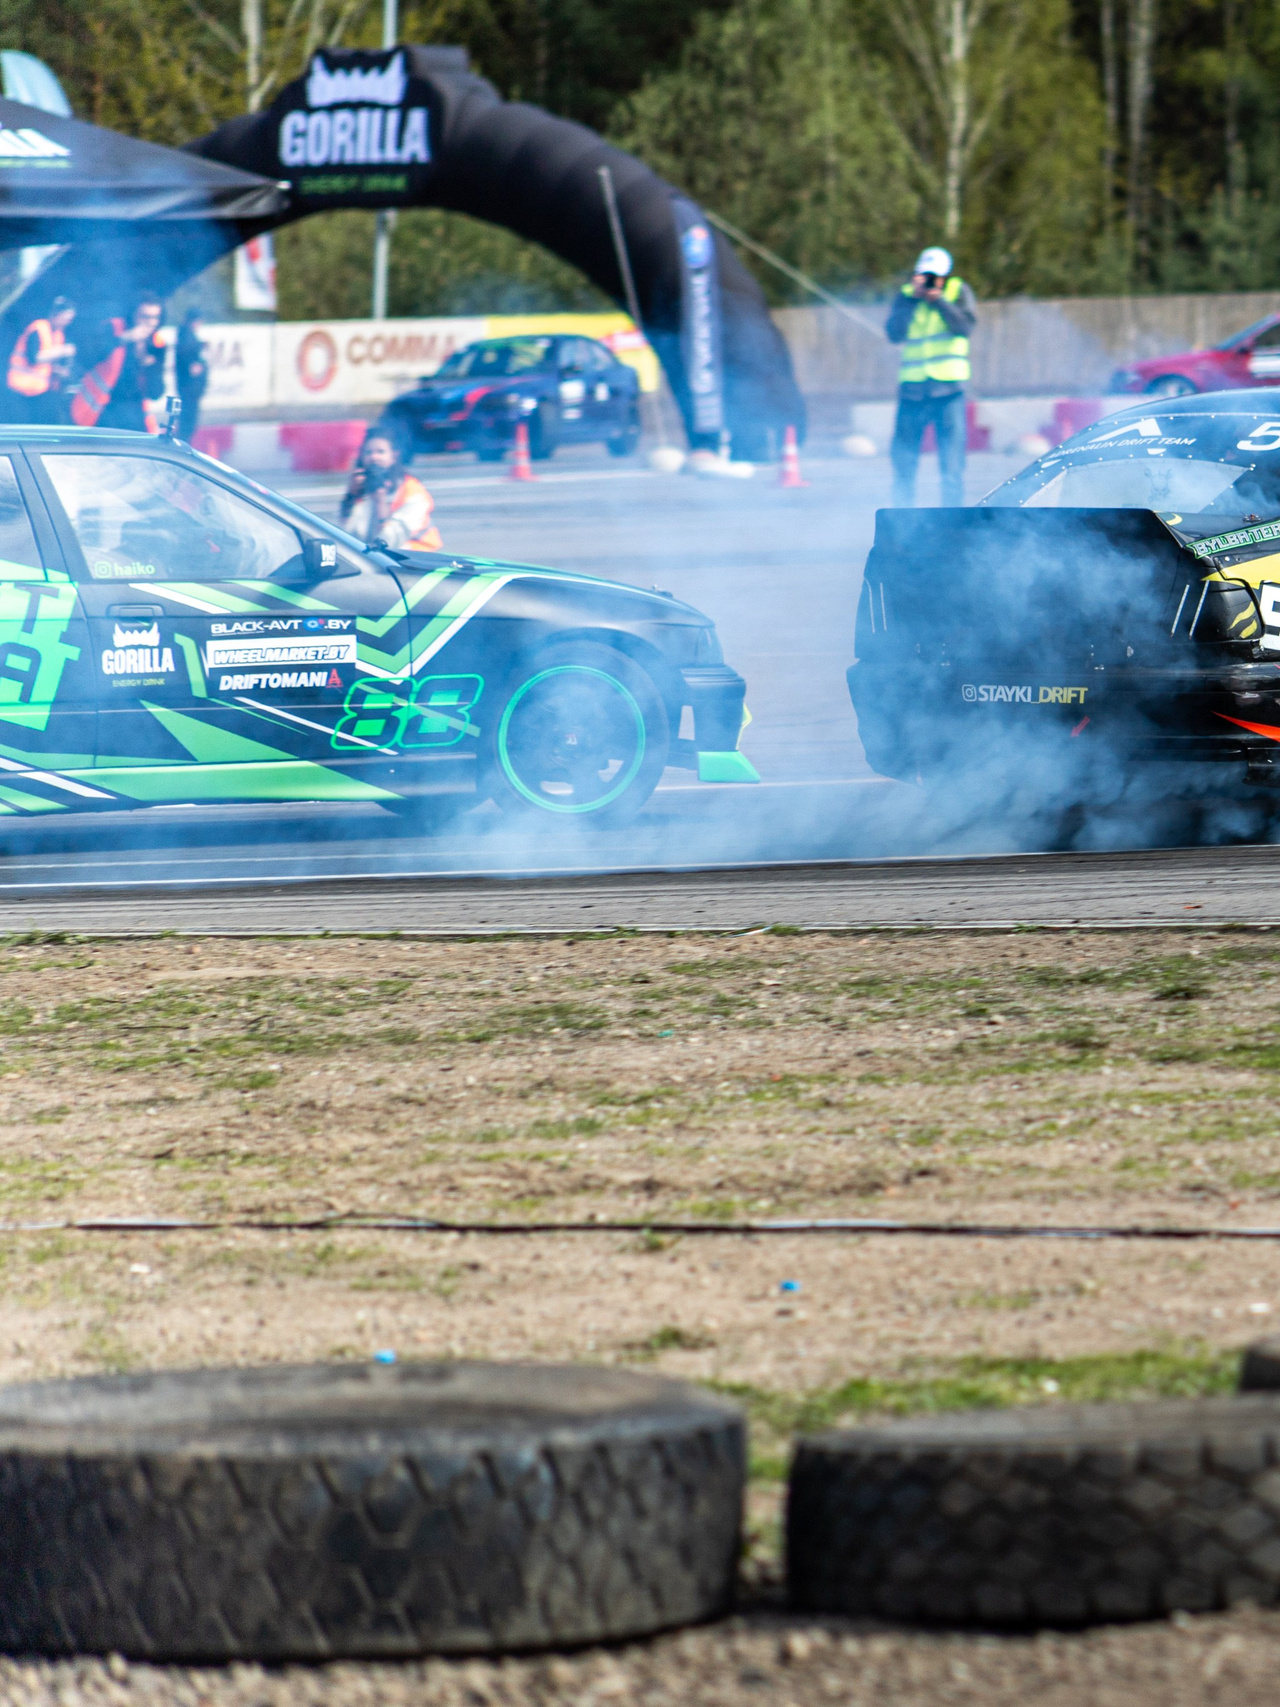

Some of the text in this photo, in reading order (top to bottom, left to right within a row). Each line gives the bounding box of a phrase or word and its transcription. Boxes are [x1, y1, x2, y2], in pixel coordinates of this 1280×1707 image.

[279, 106, 432, 168] GORILLA
[1117, 437, 1158, 447] DRIFT
[1158, 437, 1197, 446] TEAM
[114, 561, 156, 576] haiko
[102, 647, 175, 675] GORILLA
[213, 645, 351, 666] WHEELMARKET.BY
[218, 668, 344, 691] DRIFTOMANIA
[978, 685, 1089, 704] STAYKI_DRIFT
[330, 673, 485, 750] 88
